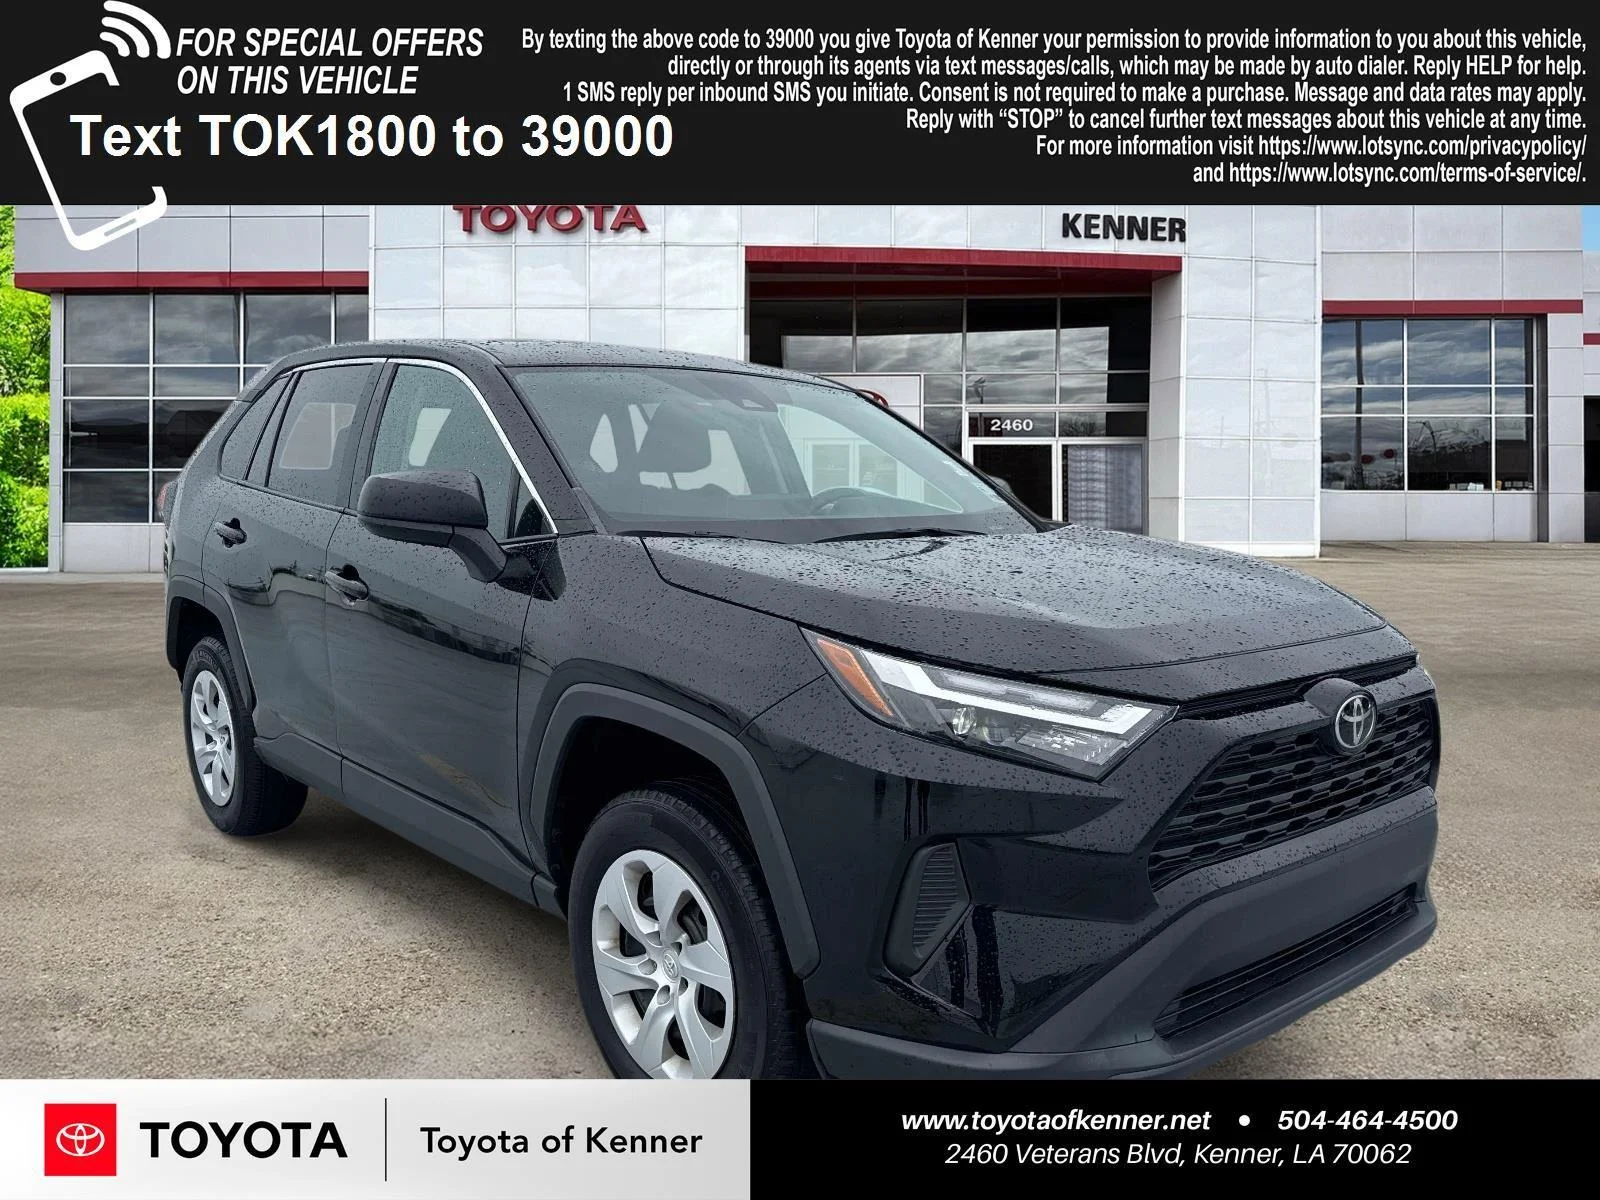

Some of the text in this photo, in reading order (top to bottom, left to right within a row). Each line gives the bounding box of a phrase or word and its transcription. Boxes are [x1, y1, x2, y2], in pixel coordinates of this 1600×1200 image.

[453, 205, 646, 232] TOYOTA
[1062, 213, 1186, 242] KENNER
[990, 418, 1033, 433] 2460
